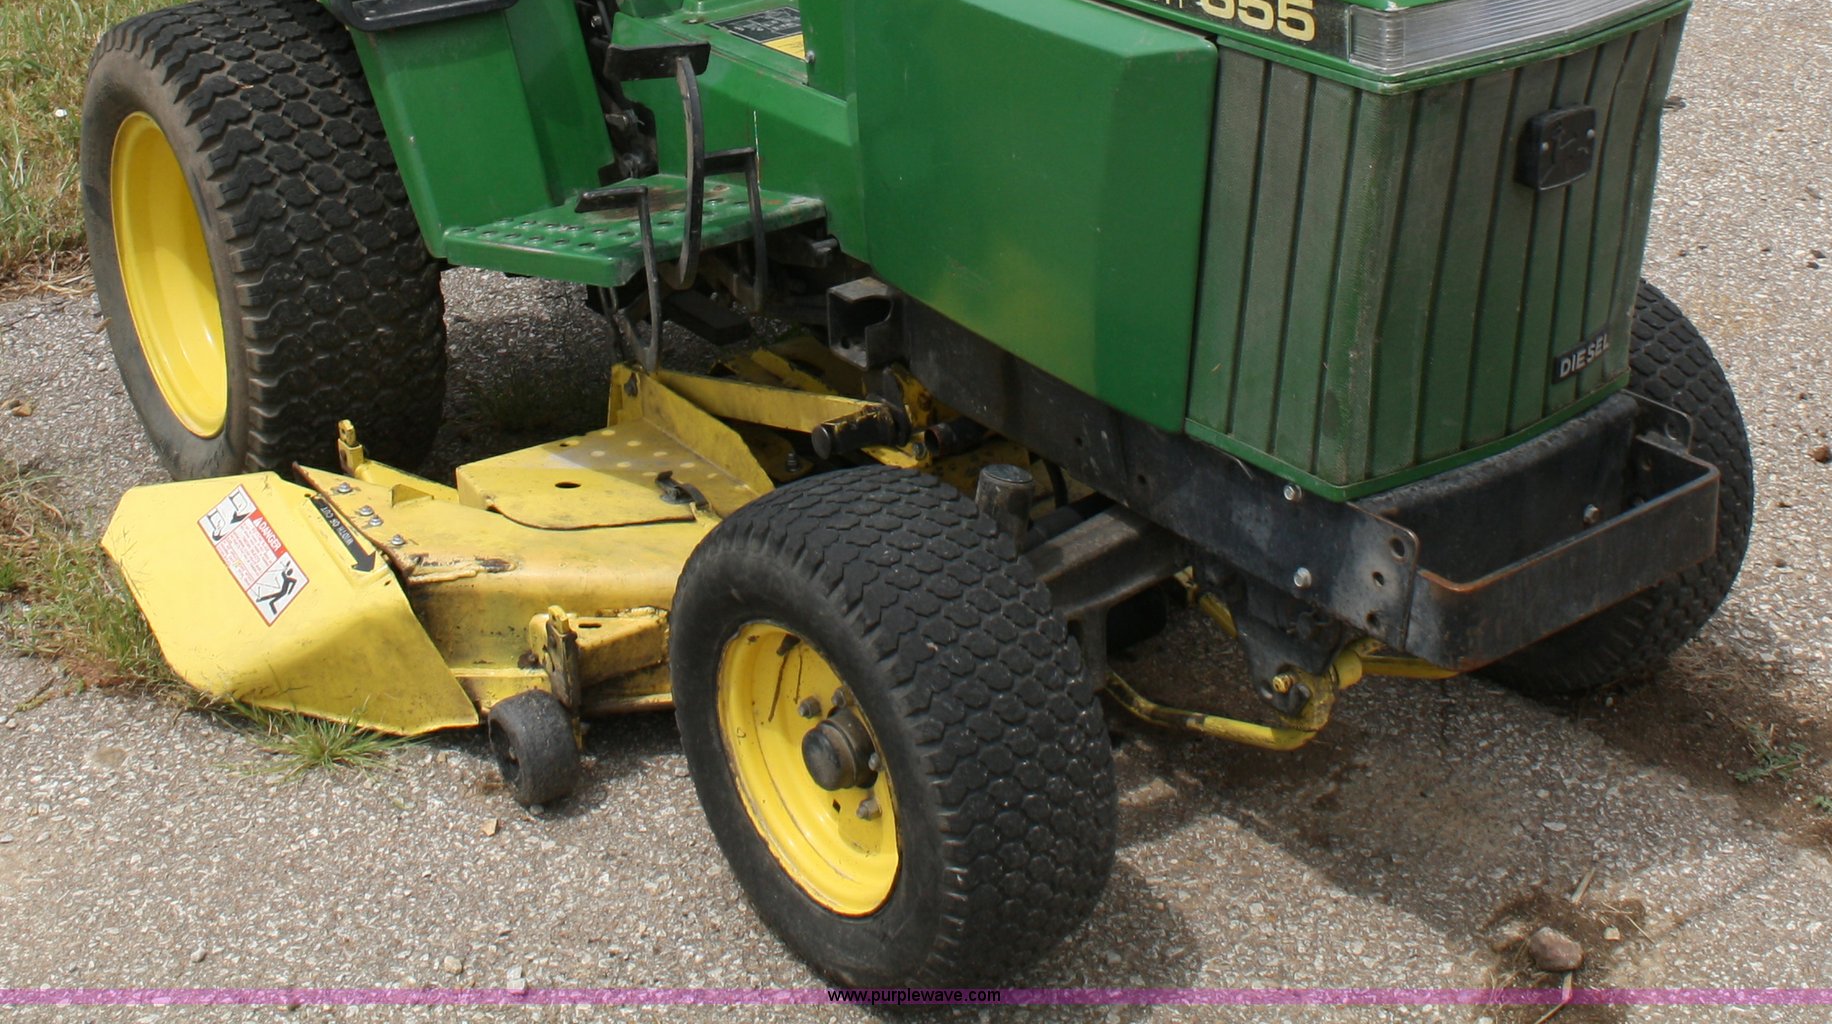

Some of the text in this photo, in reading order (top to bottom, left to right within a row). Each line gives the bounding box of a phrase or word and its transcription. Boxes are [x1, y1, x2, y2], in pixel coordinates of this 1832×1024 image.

[1559, 333, 1610, 378] DIESEL
[258, 521, 282, 553] DANGER
[320, 504, 353, 546] WIDTH OF CUT
